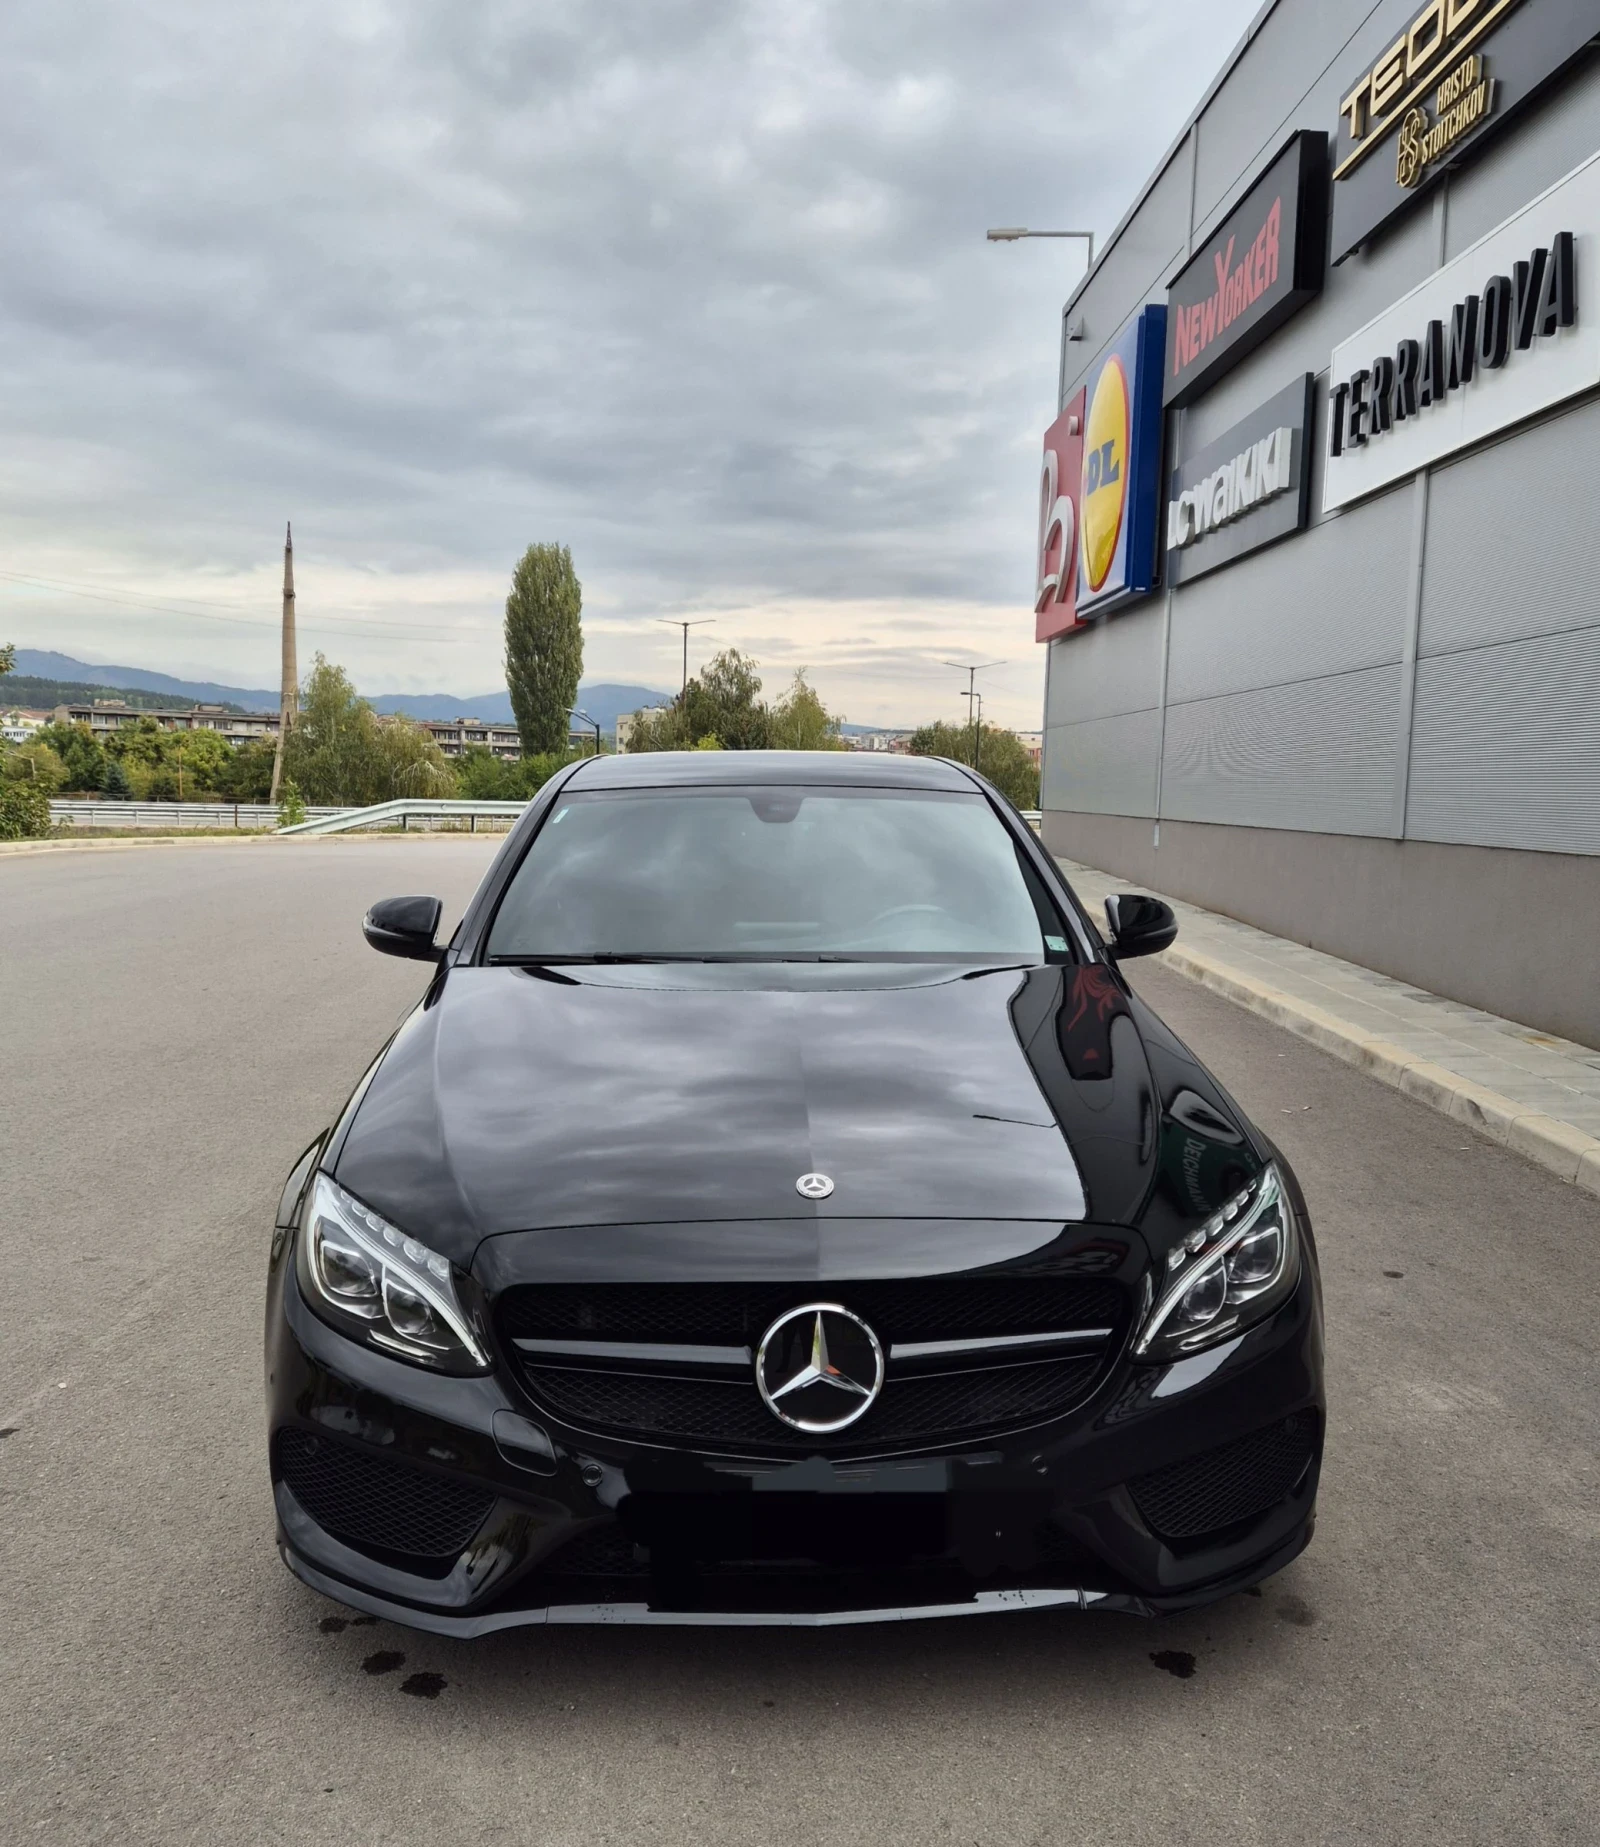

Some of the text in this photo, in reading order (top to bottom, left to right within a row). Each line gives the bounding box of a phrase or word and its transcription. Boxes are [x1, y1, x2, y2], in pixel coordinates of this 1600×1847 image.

[1421, 79, 1487, 165] STOITCHKOV
[1436, 54, 1475, 115] HRISTO
[1330, 231, 1575, 457] TERRANOVA
